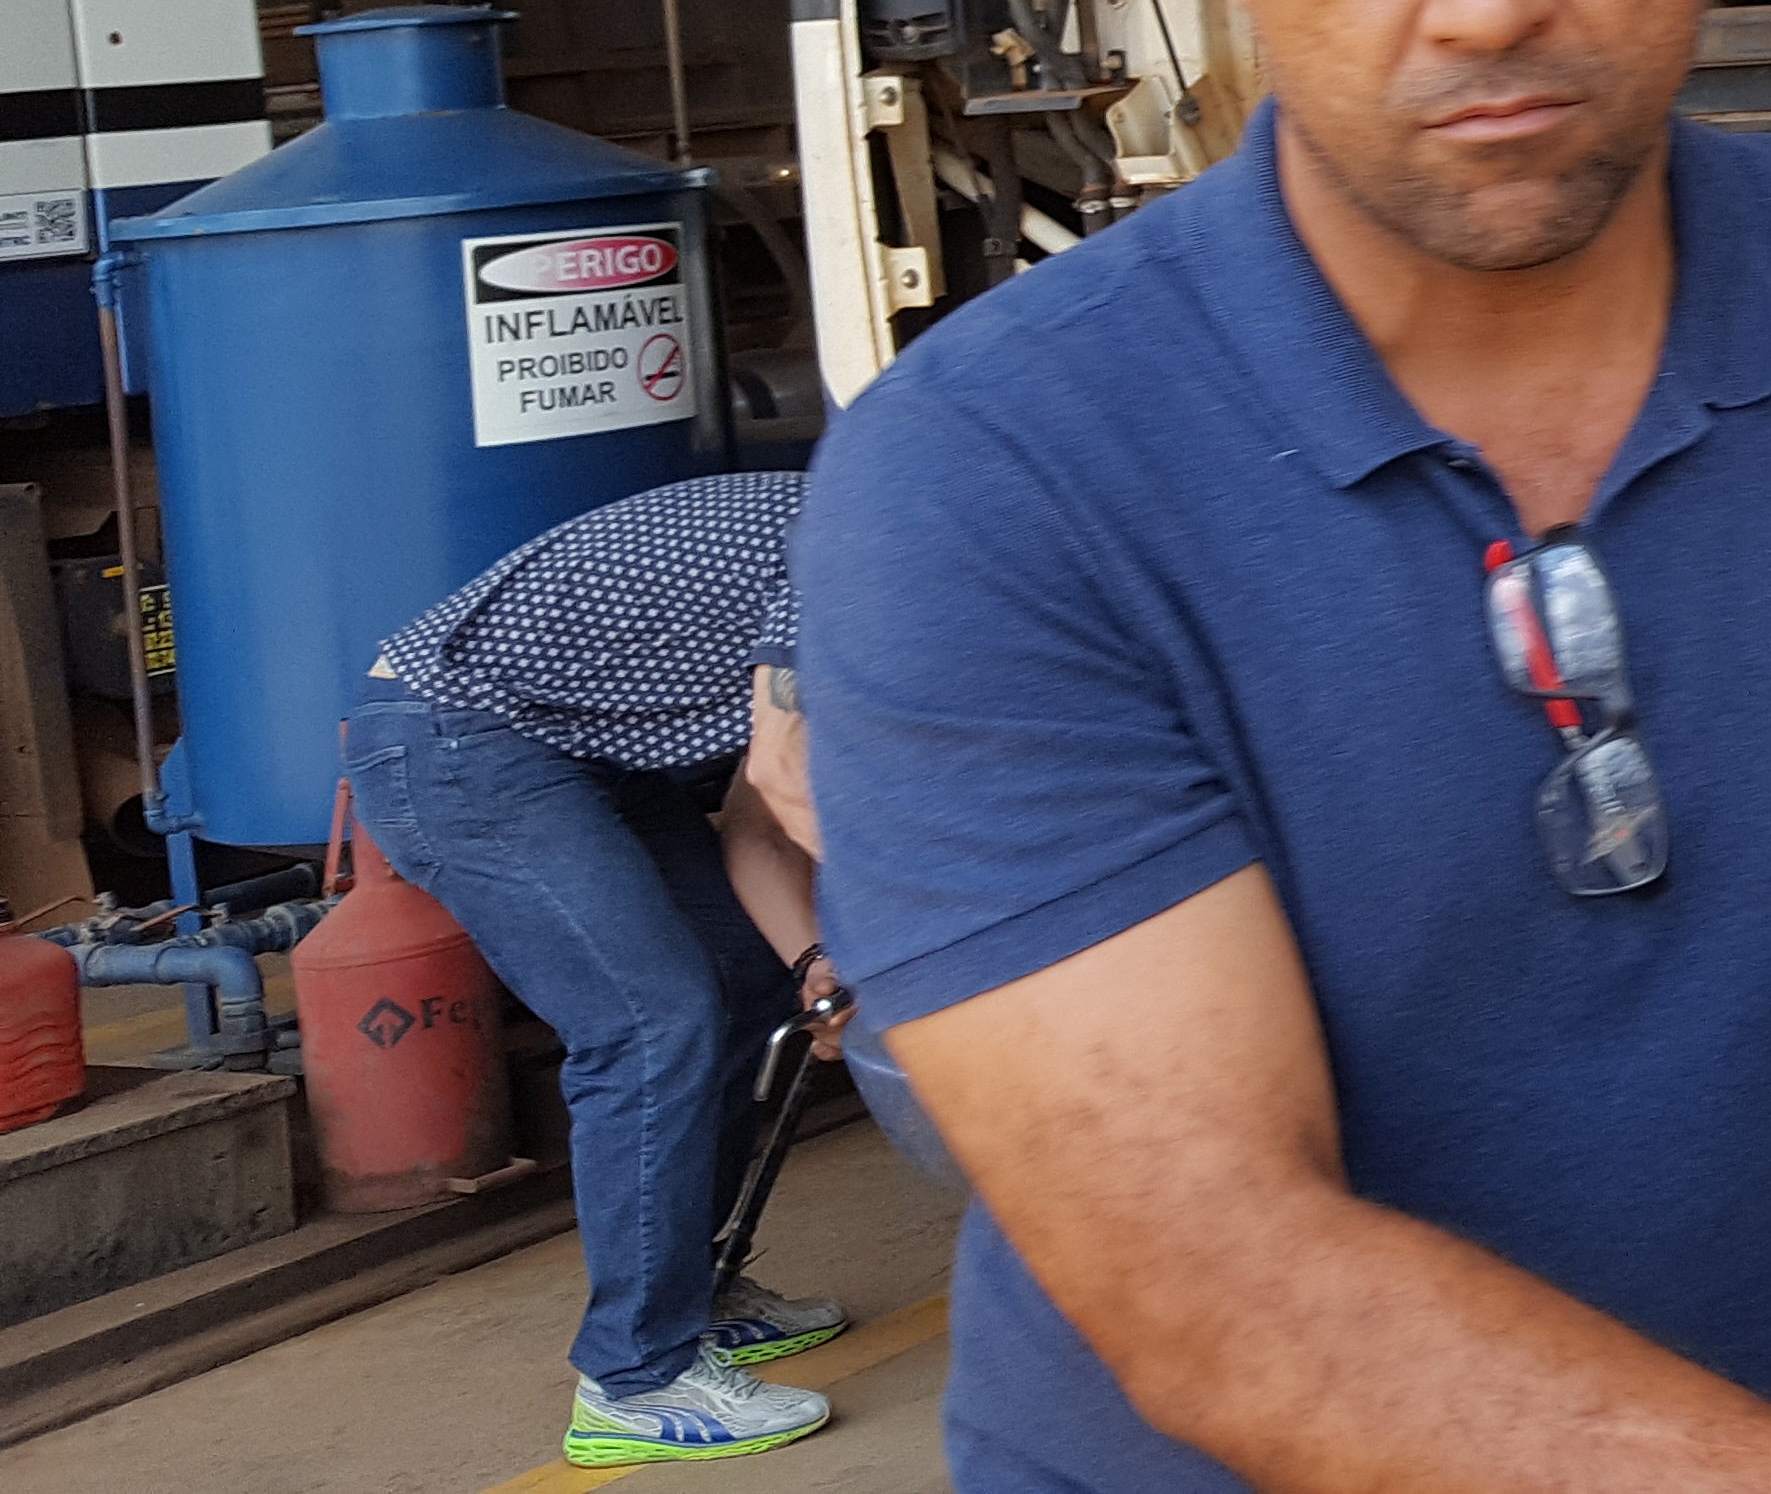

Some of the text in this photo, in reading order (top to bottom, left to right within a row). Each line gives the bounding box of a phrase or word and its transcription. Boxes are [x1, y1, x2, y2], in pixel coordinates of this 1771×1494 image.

[485, 294, 684, 344] INFLAMÁVEL
[497, 347, 629, 383] PROIBIDO
[520, 381, 617, 414] FUMAR
